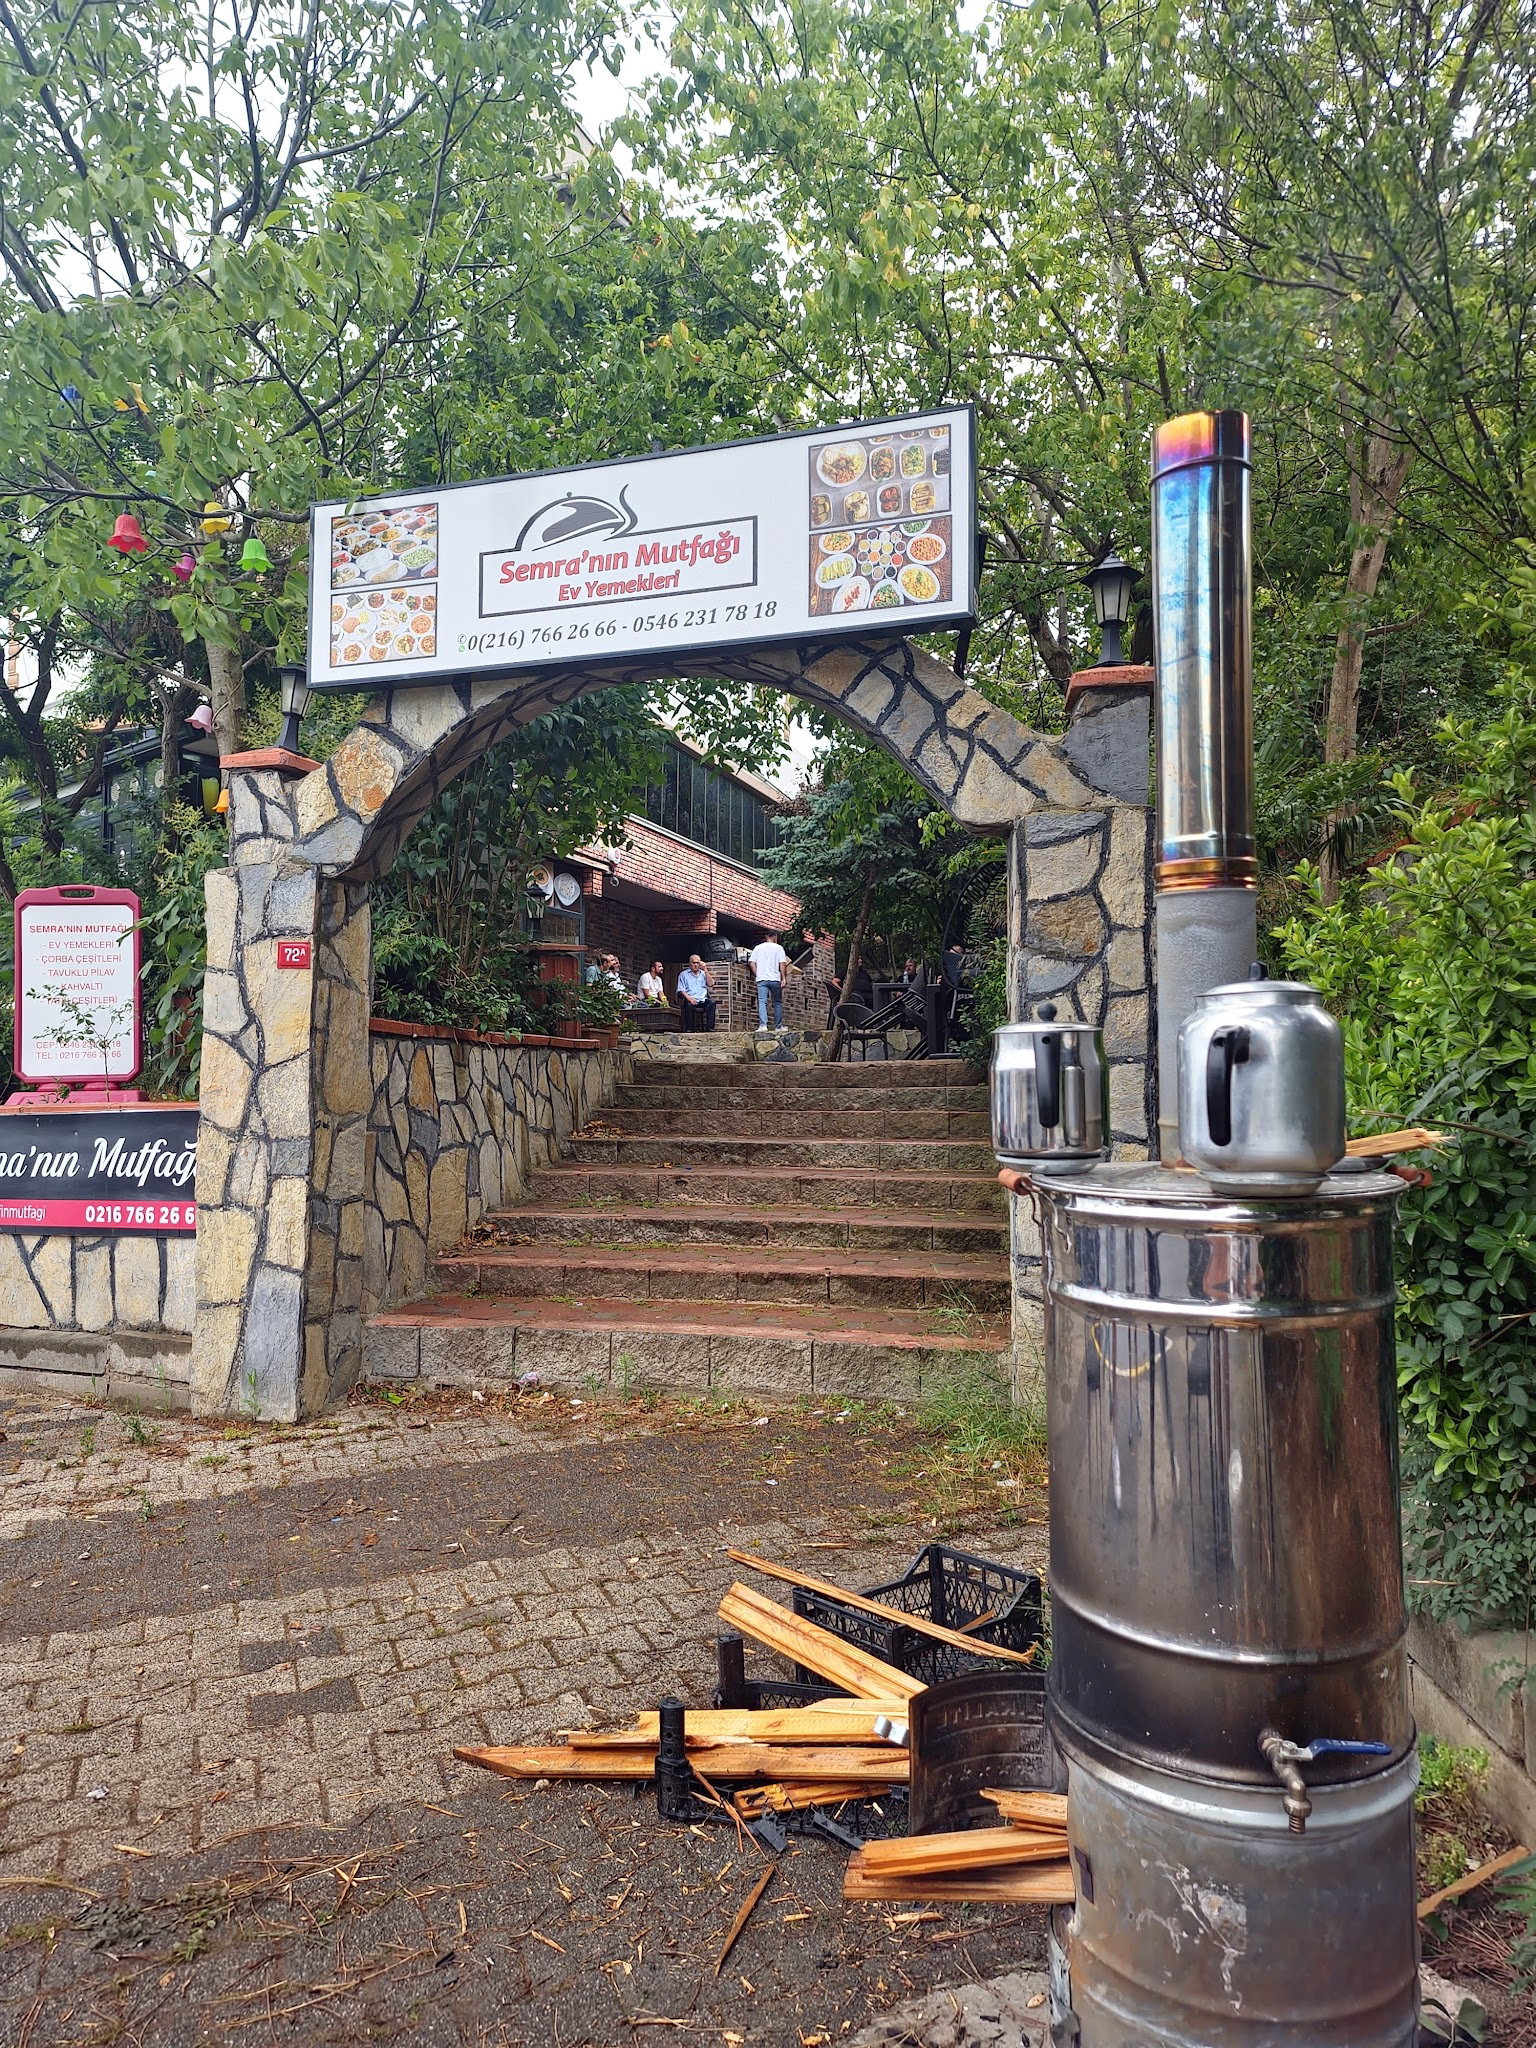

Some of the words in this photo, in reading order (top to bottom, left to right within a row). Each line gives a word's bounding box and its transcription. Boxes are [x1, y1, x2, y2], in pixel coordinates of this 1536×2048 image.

[500, 550, 628, 584] Semra'nın
[635, 530, 740, 566] Mutfağı
[558, 583, 581, 602] Ev
[584, 570, 680, 598] Yemekleri
[467, 630, 525, 652] 0(216)
[531, 626, 562, 644] 766
[568, 623, 590, 640] 26
[594, 620, 616, 637] 66
[634, 612, 678, 632] 0546
[684, 609, 717, 628] 231
[724, 604, 747, 622] 78
[754, 600, 777, 619] 18
[29, 925, 82, 933] SEMRA'NIN
[64, 940, 114, 948] YEMEKLERİ
[42, 955, 74, 964] ÇORBA
[76, 954, 122, 964] ÇEŞİTLERİ
[284, 948, 306, 962] 72A
[91, 968, 115, 976] PİLAV
[61, 982, 103, 990] KAHVALTI
[85, 1205, 122, 1223] 0216
[126, 1206, 154, 1224] 766
[160, 1206, 180, 1224] 26
